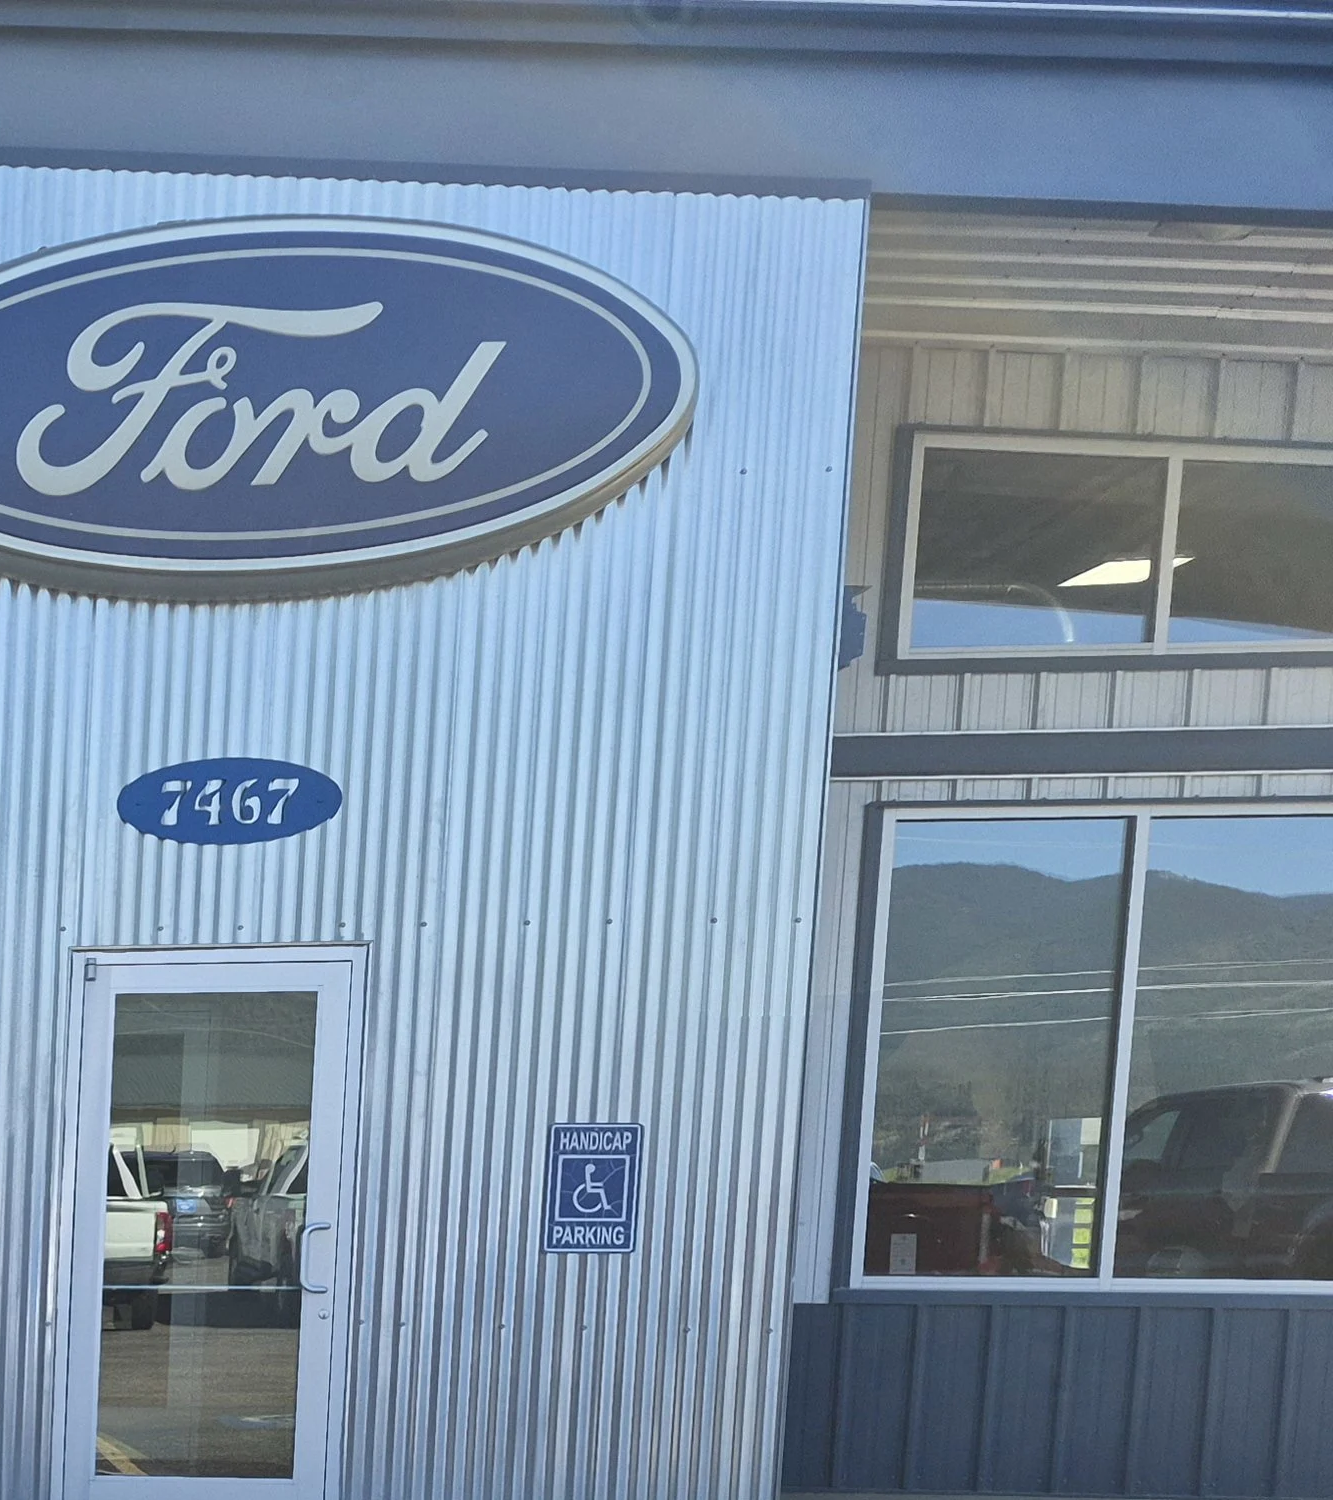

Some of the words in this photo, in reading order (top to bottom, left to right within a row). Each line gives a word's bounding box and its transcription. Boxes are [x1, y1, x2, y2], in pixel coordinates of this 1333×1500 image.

[15, 299, 507, 497] Ford
[159, 778, 300, 827] 7467
[559, 1131, 633, 1151] HANDICAP
[552, 1225, 626, 1246] PARKING
